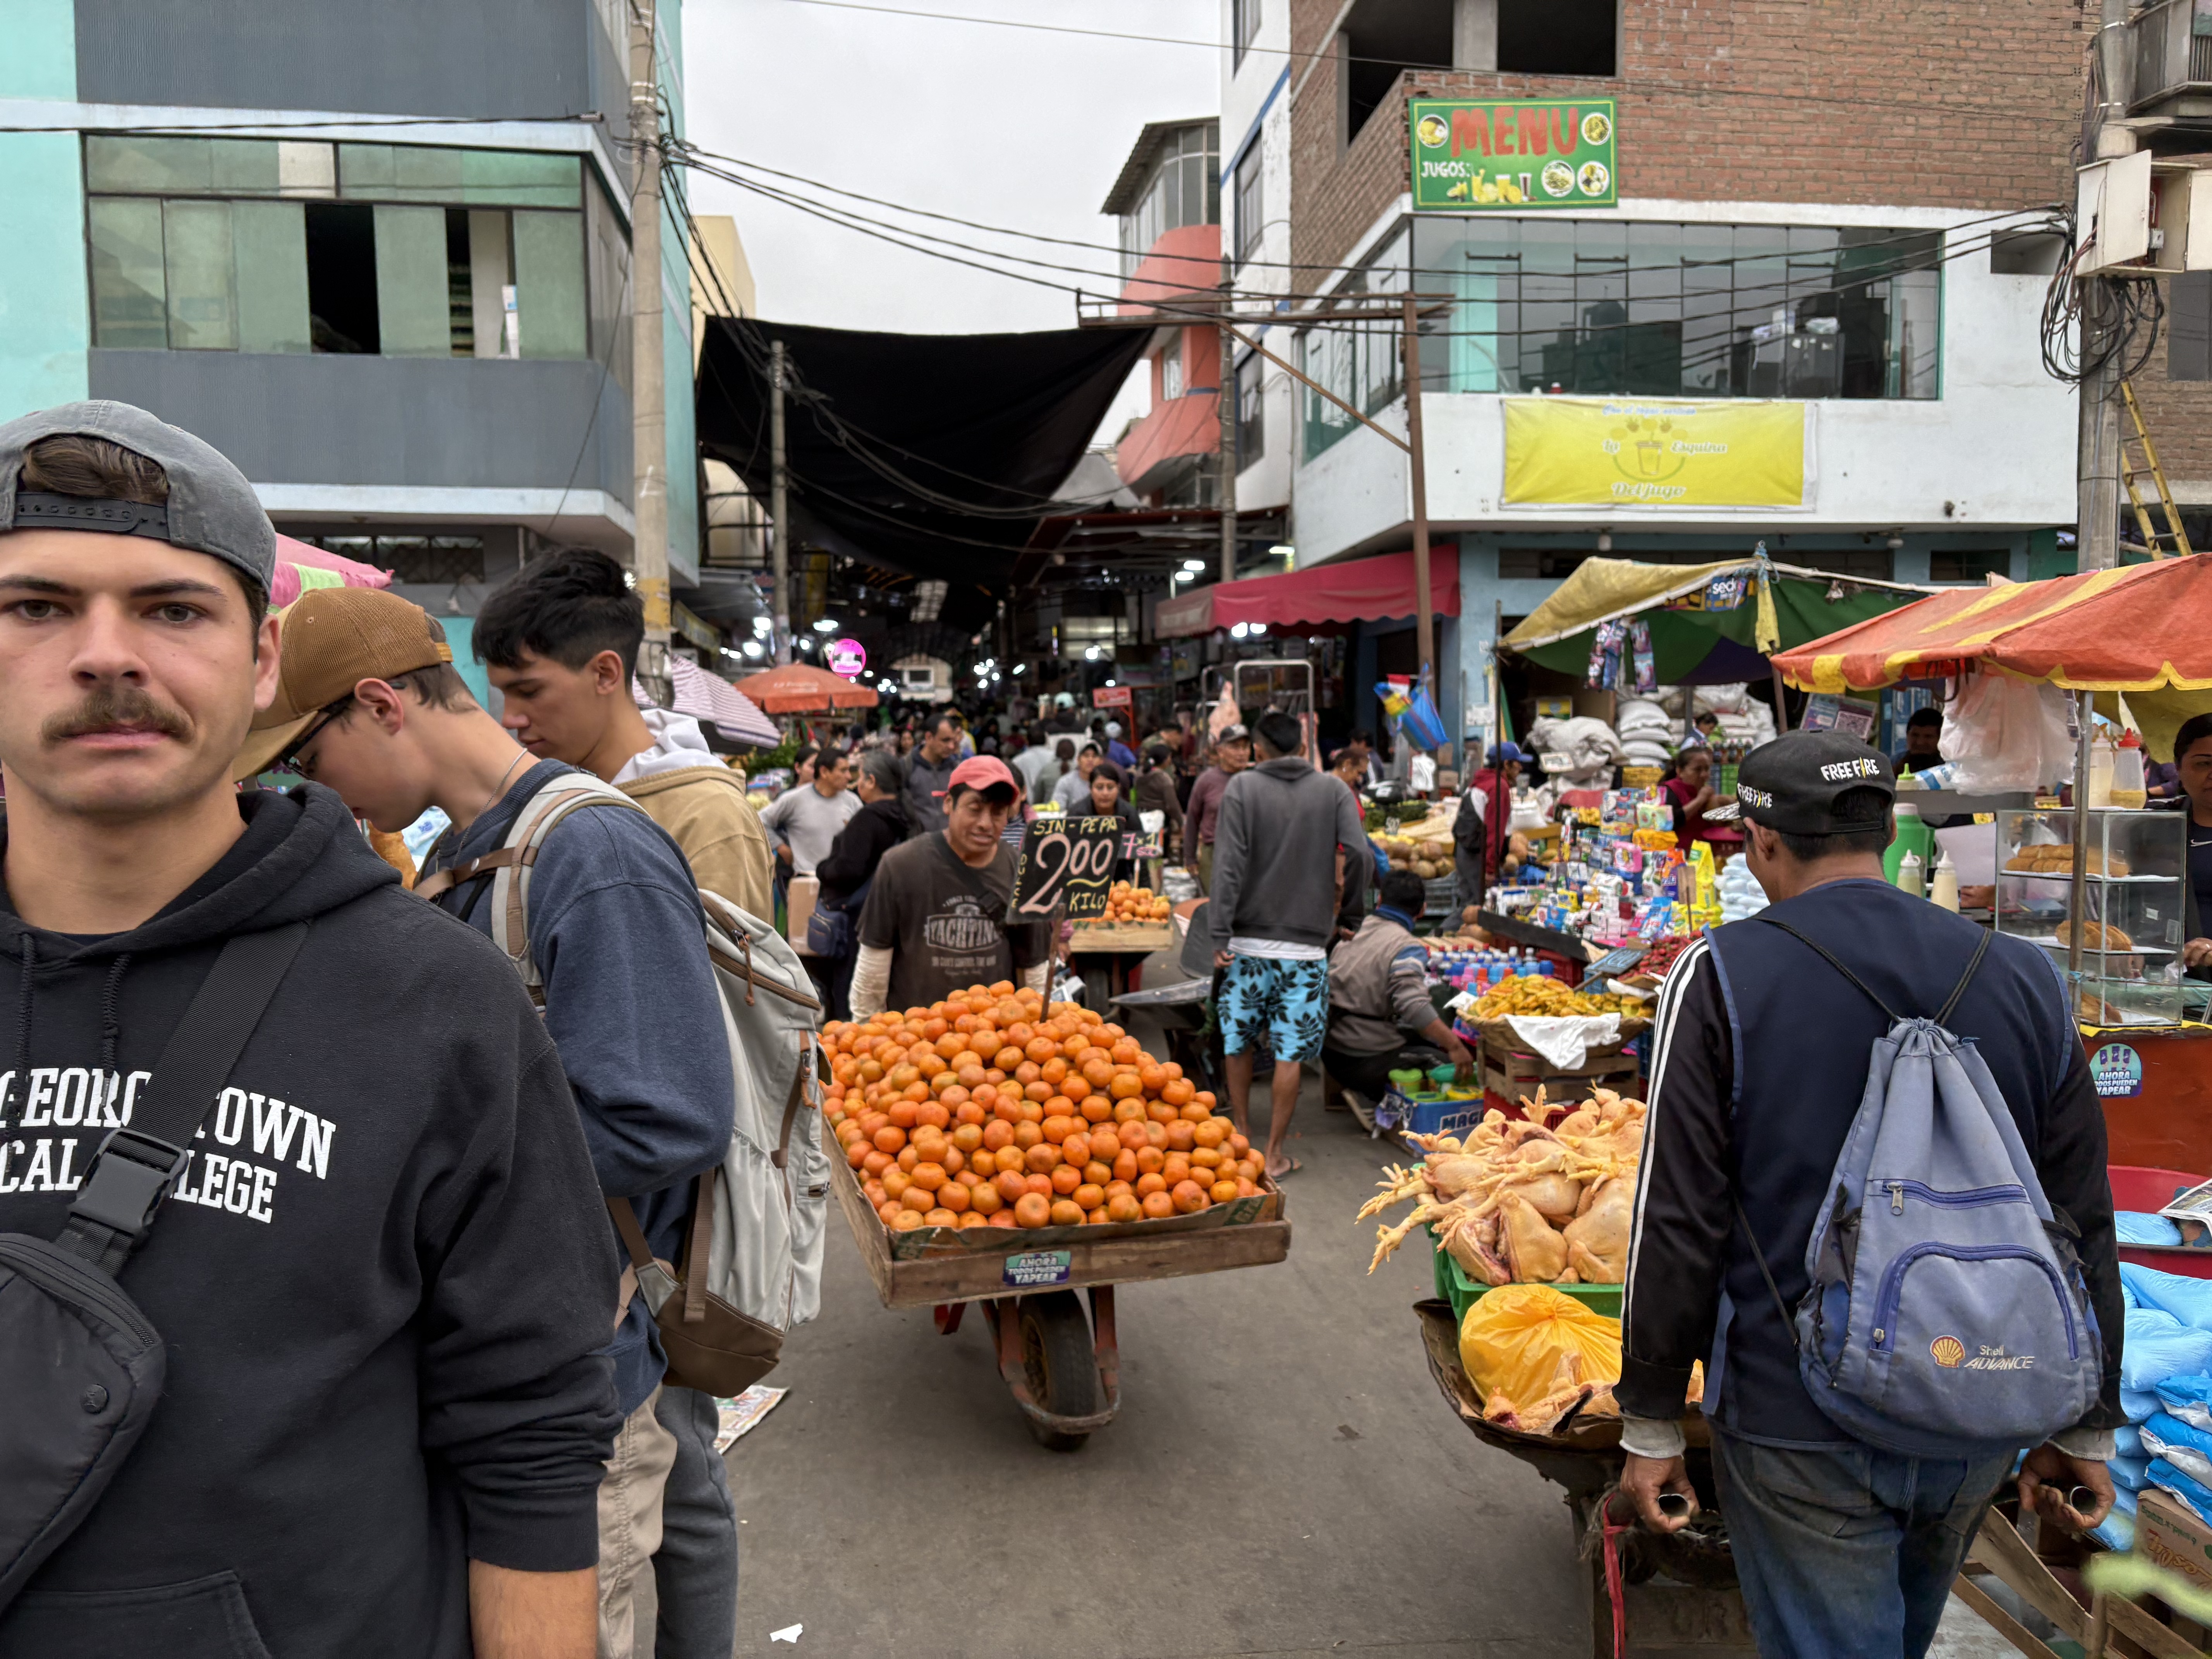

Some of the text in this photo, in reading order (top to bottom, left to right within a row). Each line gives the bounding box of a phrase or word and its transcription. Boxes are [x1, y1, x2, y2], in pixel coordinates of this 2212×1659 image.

[1450, 106, 1578, 157] MENU
[1671, 440, 1727, 455] Esquina
[1820, 756, 1880, 781] FREE FIRE
[1737, 783, 1772, 808] FREE FIRE
[1034, 819, 1066, 836] SIN
[1080, 817, 1118, 835] PEPA
[1012, 854, 1027, 908] DULCE
[1069, 892, 1106, 912] KILO
[931, 918, 999, 948] YACHTIN
[2098, 1072, 2130, 1080] AHORA
[2096, 1086, 2131, 1096] YAPEAR
[170, 1150, 277, 1223] LEGE
[1980, 1345, 2004, 1356] Shell
[1964, 1356, 2035, 1370] ADVANCE
